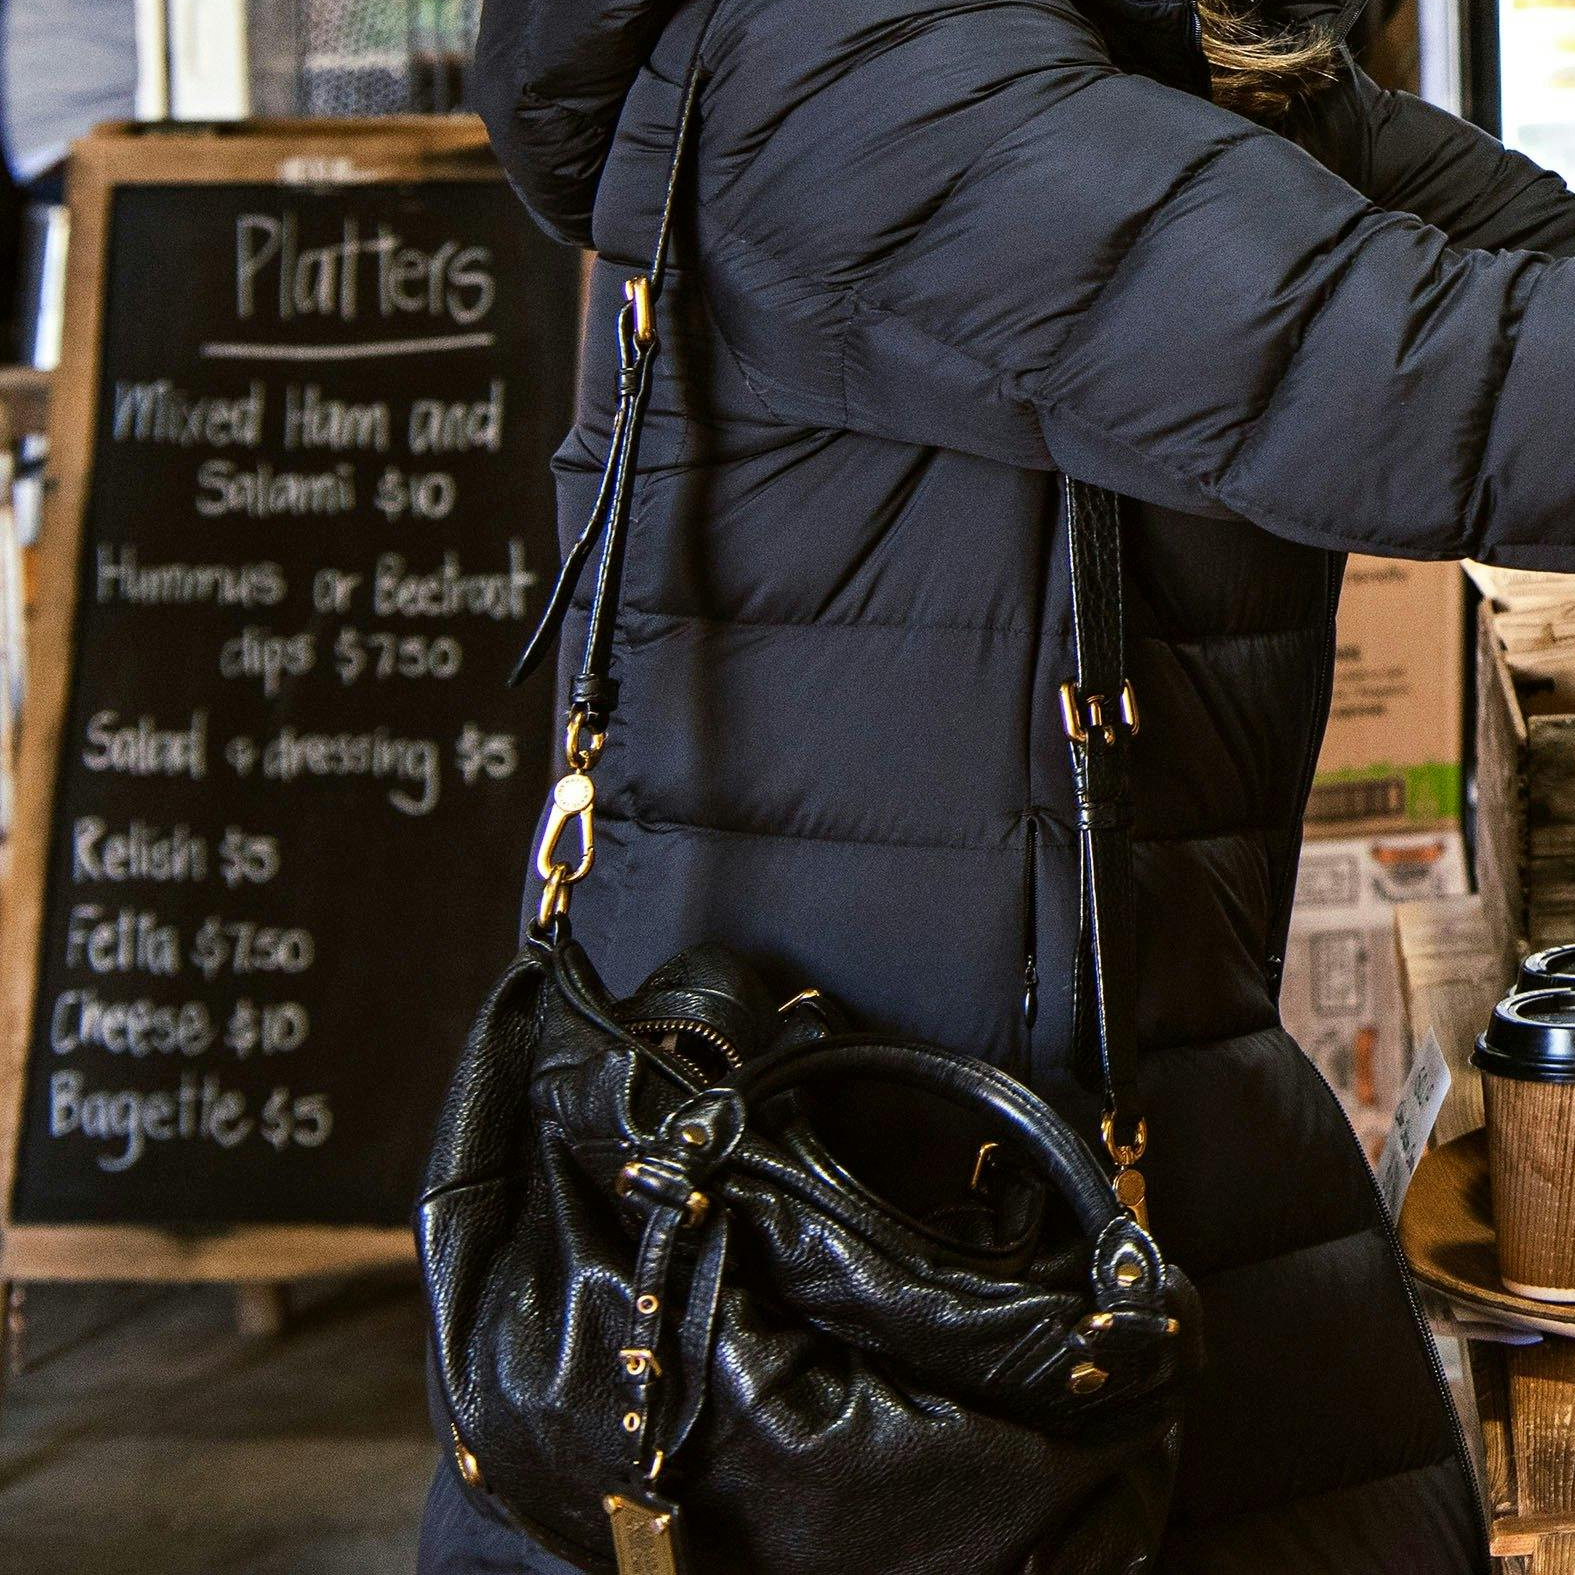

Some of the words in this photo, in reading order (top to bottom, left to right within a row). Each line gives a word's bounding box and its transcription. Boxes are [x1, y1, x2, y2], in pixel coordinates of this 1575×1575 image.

[236, 213, 496, 323] Platters
[113, 380, 265, 448] Mixed
[285, 381, 390, 451] Ham
[408, 378, 505, 452] and
[197, 460, 356, 518] Salami
[376, 466, 457, 521] $10
[97, 543, 288, 608] Hummus
[219, 624, 317, 698] dips
[82, 709, 208, 778] Salad
[263, 724, 440, 816] dressing
[455, 722, 518, 784] $5
[71, 815, 207, 884] Relish
[220, 827, 281, 888] $5
[51, 989, 216, 1058] Cheese
[224, 997, 310, 1060] $10
[49, 1070, 254, 1173] Bagette
[261, 1086, 334, 1151] $5
